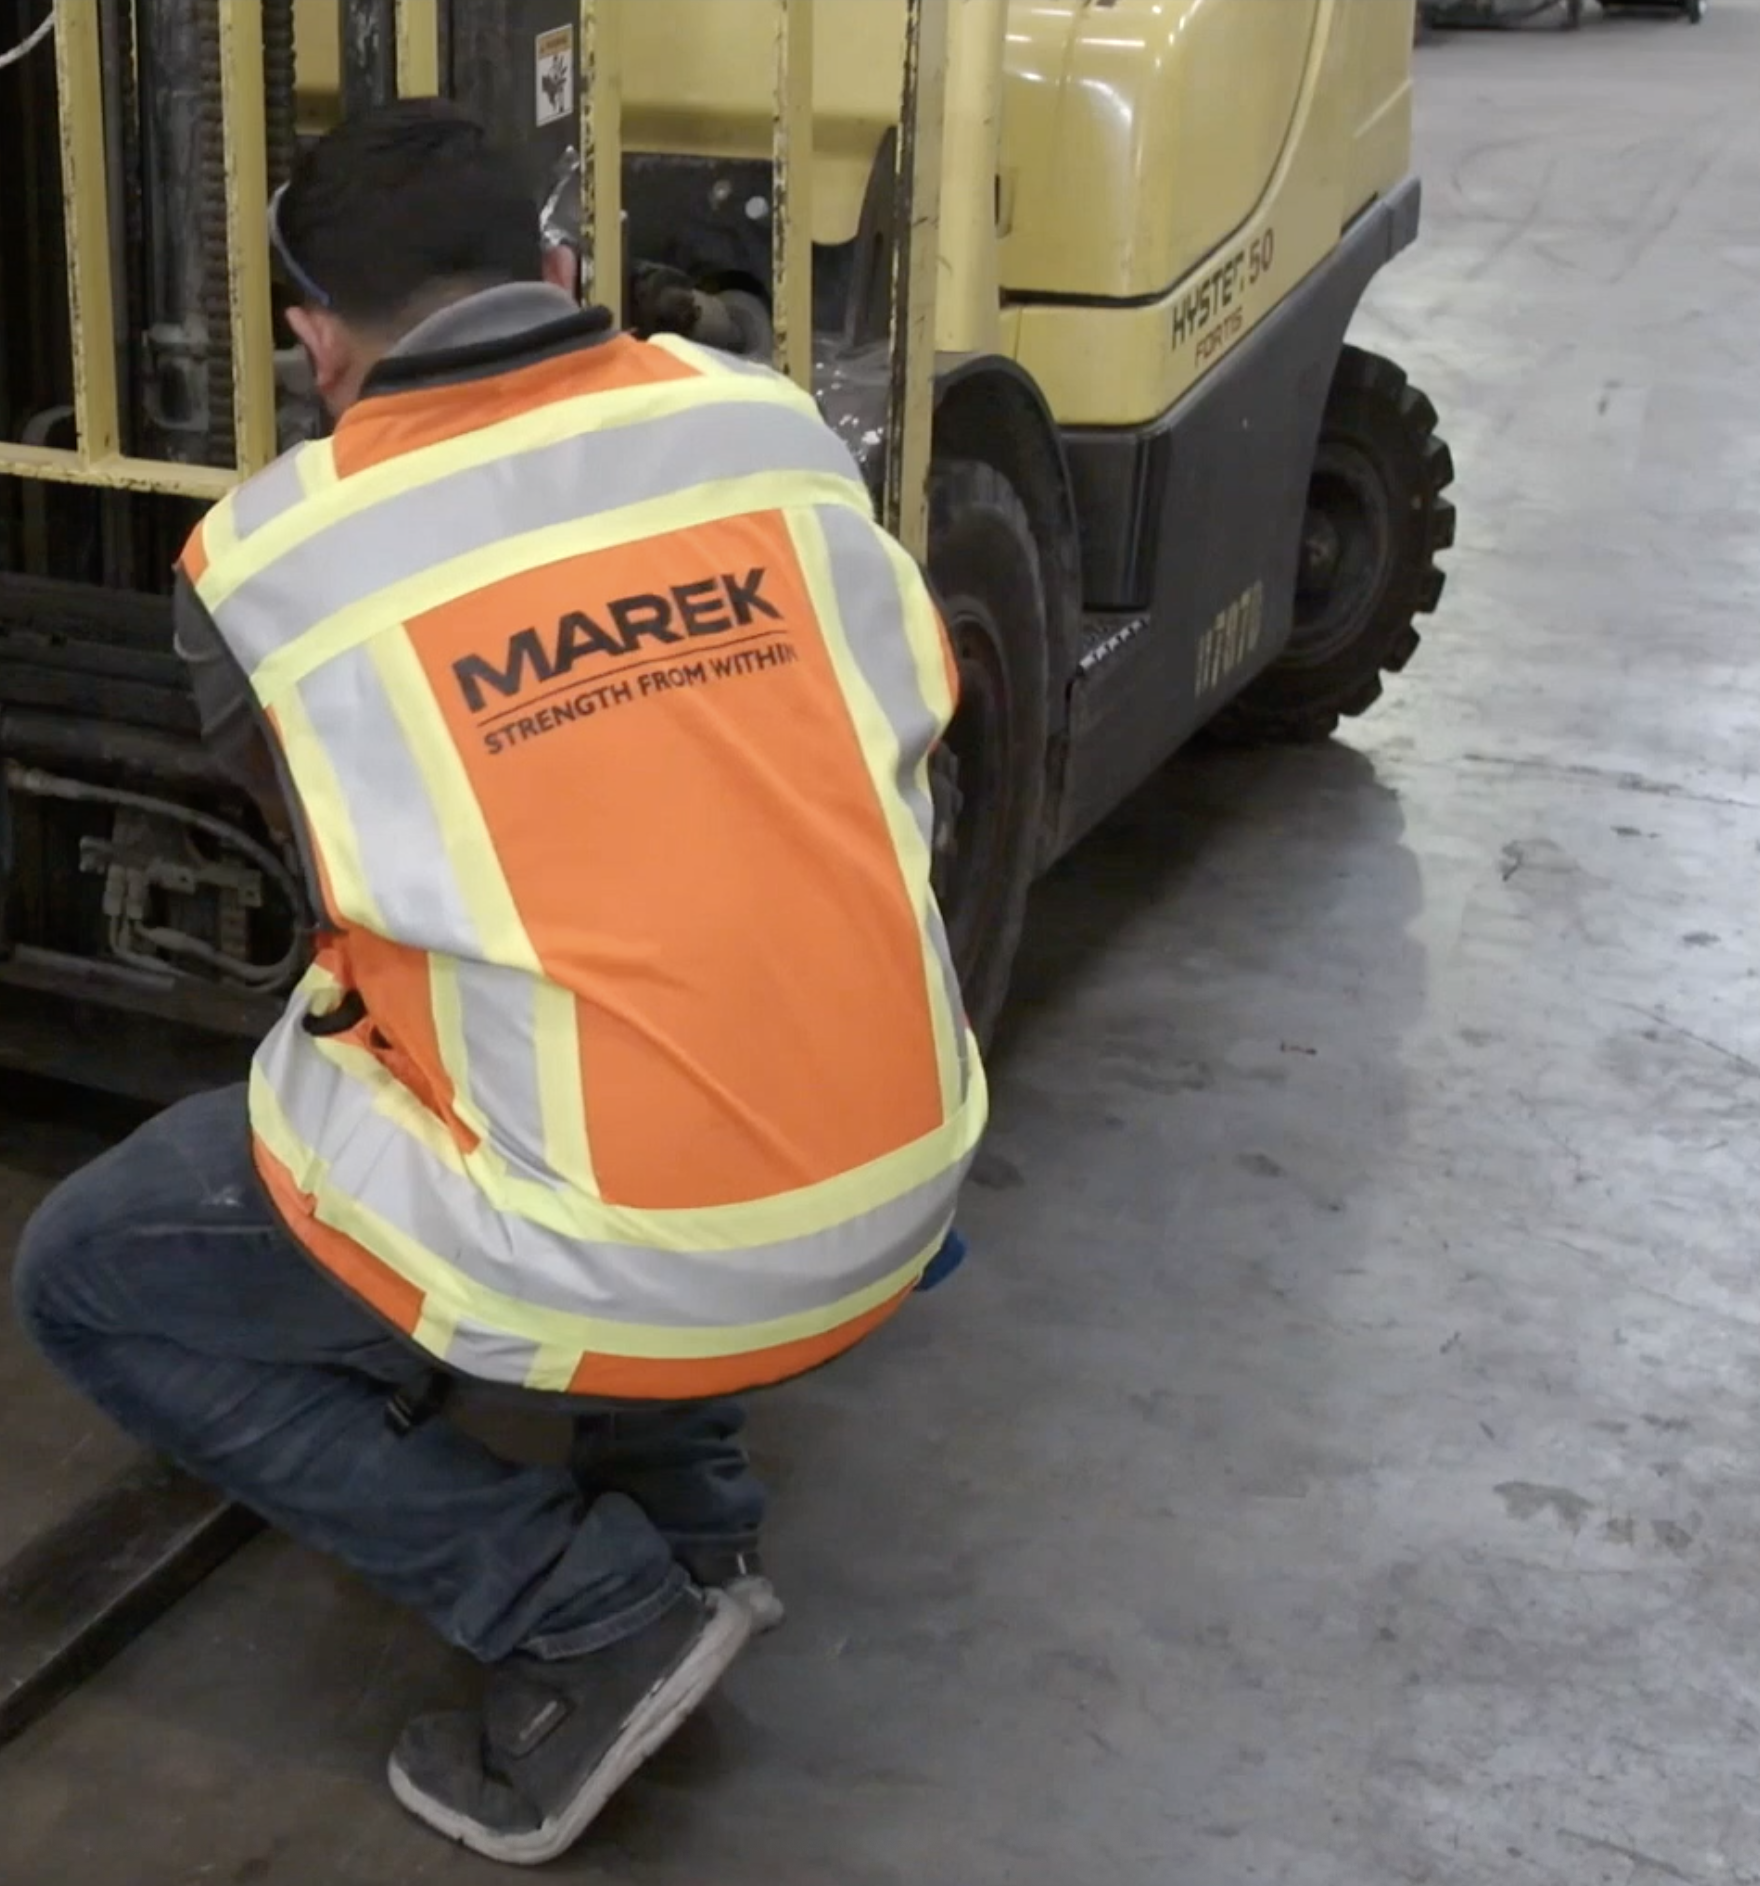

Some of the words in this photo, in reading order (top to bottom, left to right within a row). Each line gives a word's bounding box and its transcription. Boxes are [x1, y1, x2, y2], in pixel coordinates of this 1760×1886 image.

[1248, 227, 1275, 285] 50
[1194, 304, 1243, 369] FORTIS
[451, 567, 785, 714] MAREK
[483, 681, 633, 756] STRENGTH
[637, 659, 708, 697] FROM
[708, 642, 798, 678] WITHIN
